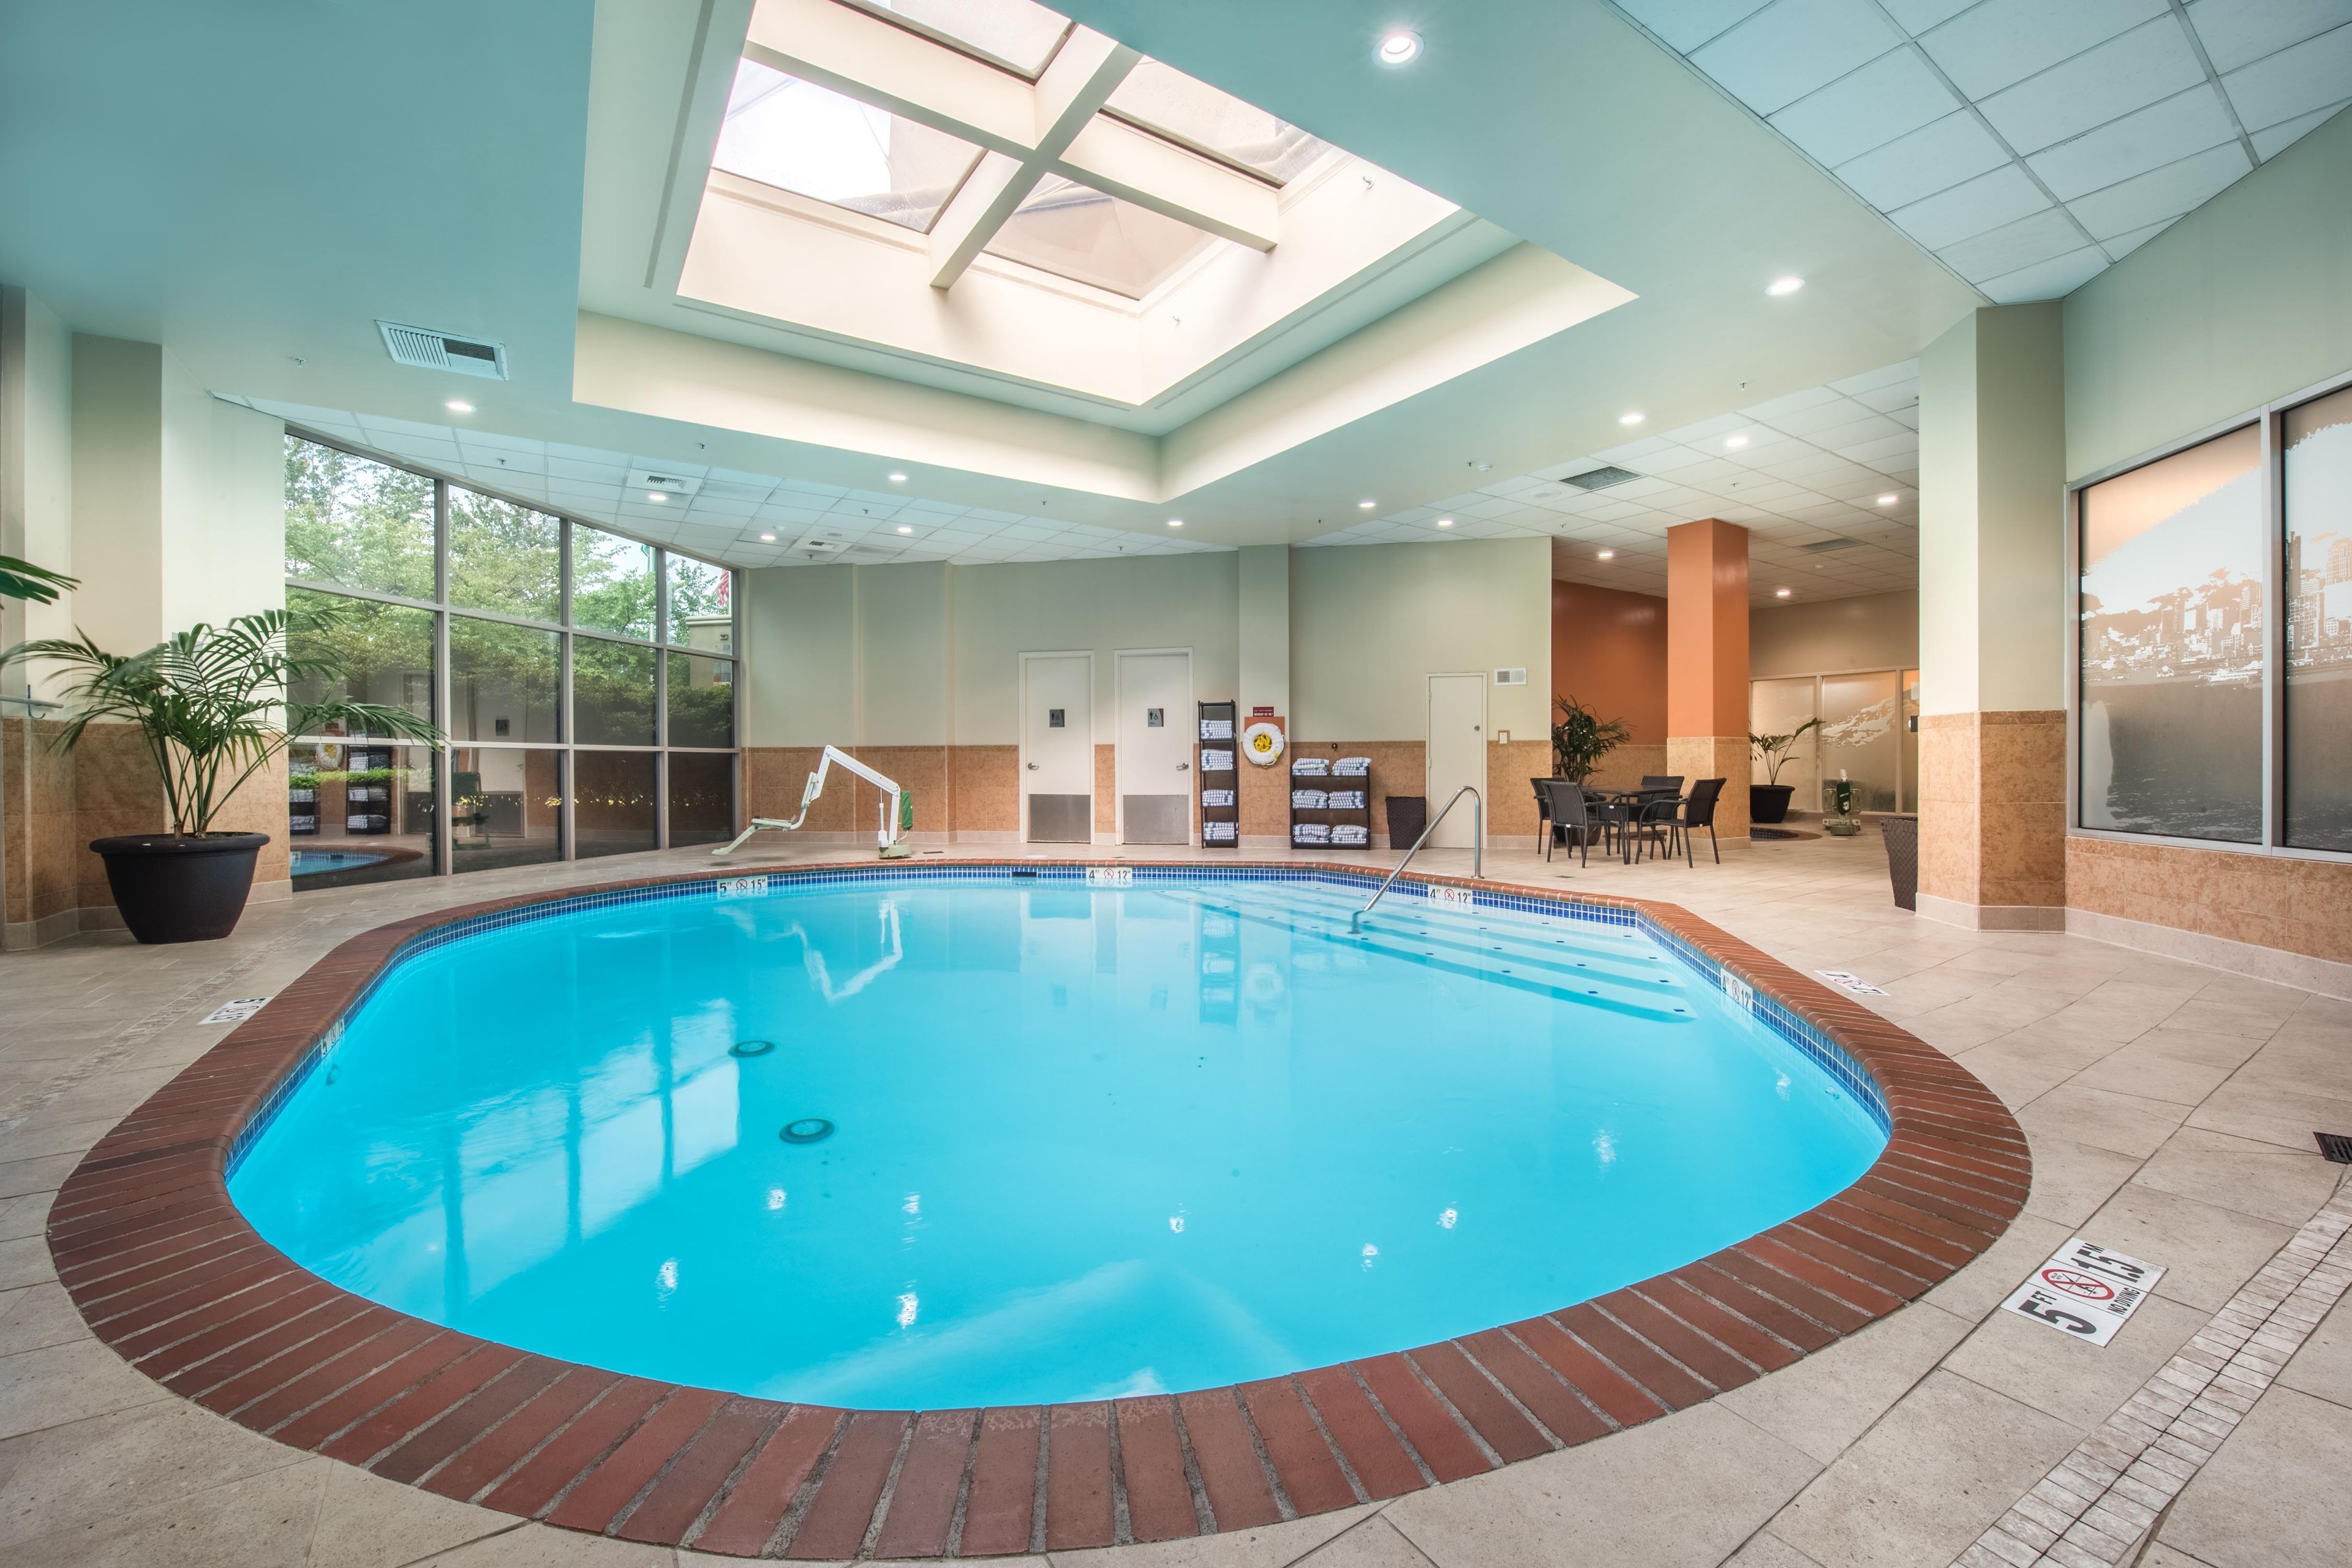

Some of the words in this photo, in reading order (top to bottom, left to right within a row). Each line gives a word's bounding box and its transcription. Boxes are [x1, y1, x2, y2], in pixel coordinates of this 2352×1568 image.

[720, 882, 727, 891] 5
[1430, 888, 1436, 899] 4
[2030, 1291, 2057, 1305] FT
[2113, 1287, 2141, 1307] DIVING
[2107, 1304, 2128, 1315] NO
[2018, 1299, 2097, 1335] 5
